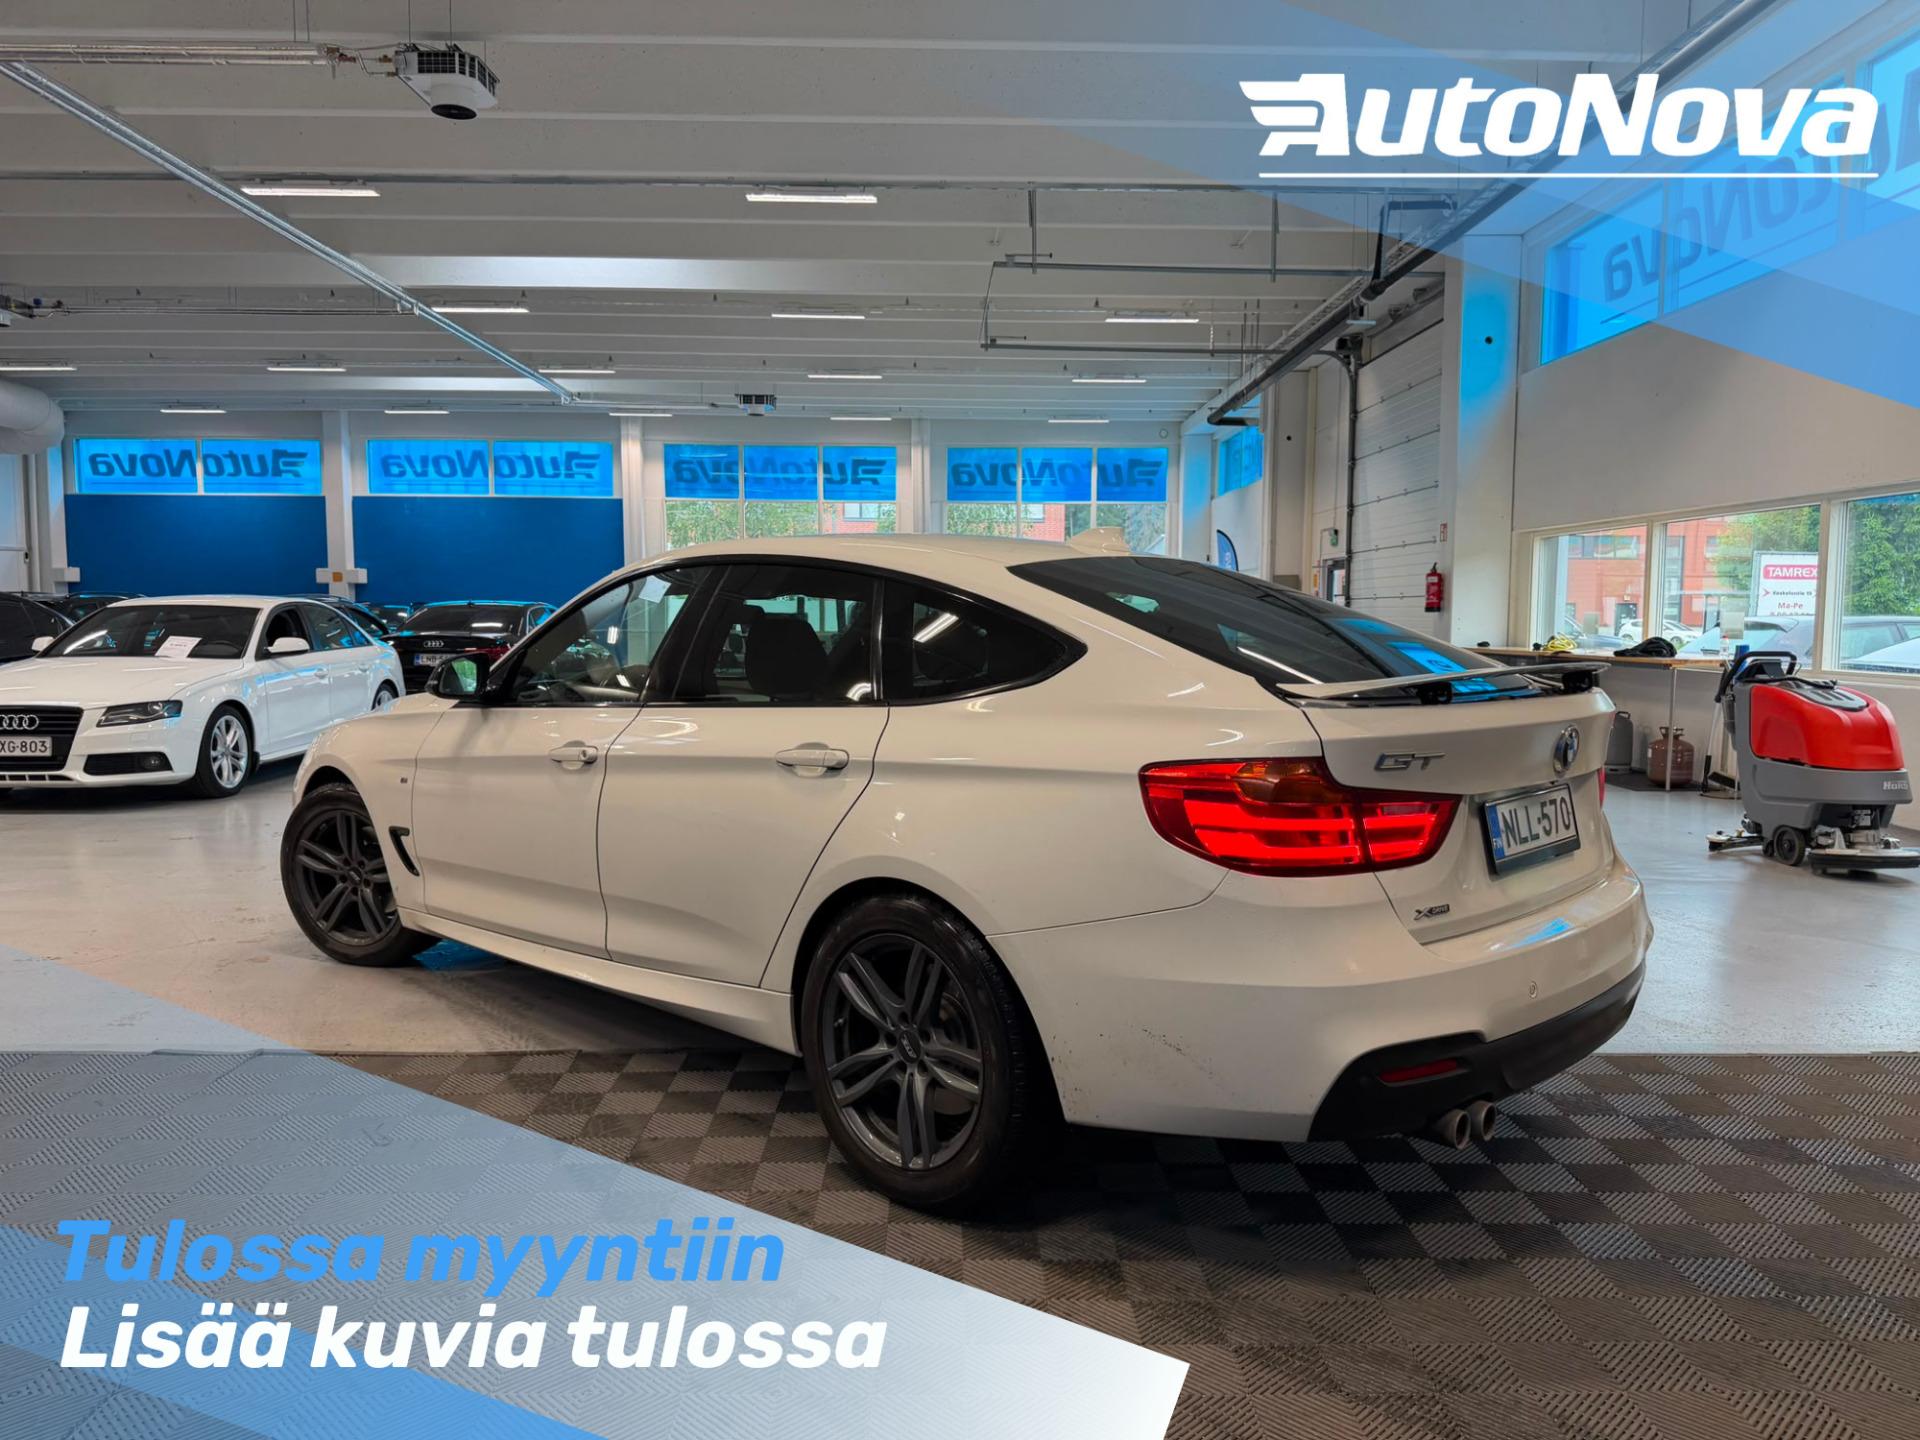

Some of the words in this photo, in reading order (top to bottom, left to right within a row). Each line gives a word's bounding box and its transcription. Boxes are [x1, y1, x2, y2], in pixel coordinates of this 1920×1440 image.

[1767, 566, 1818, 577] TAMREX
[1374, 752, 1446, 771] GT
[1501, 796, 1571, 848] NLL-570
